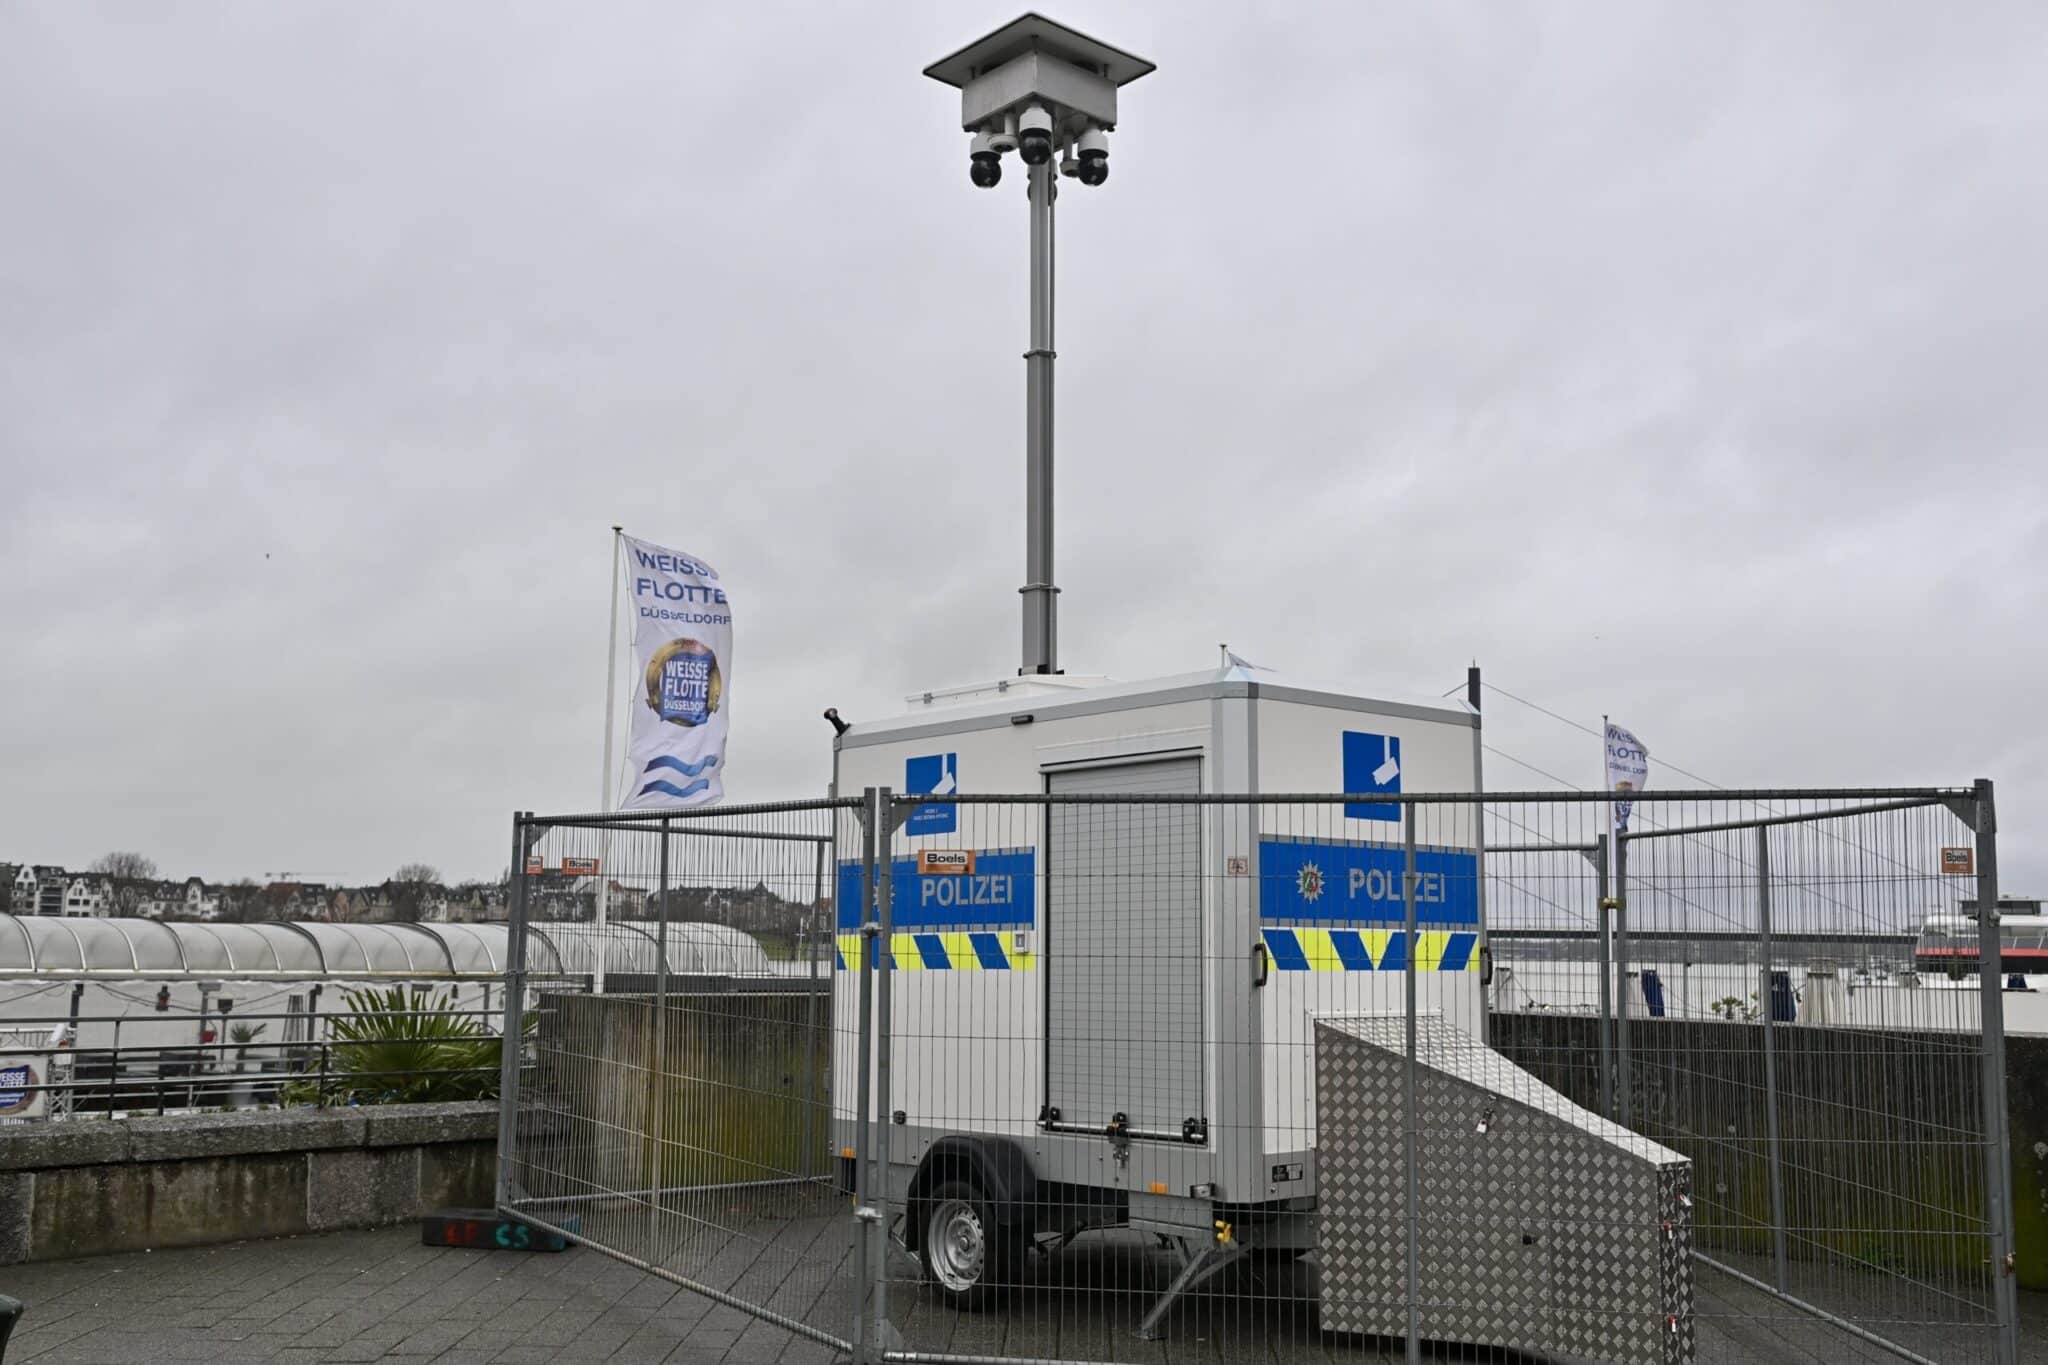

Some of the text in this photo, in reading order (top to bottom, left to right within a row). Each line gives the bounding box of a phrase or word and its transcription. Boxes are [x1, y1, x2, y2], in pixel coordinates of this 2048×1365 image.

[635, 549, 709, 577] WEISS
[637, 577, 729, 604] FLOTTE
[640, 605, 732, 624] DÜSSELDORF
[665, 660, 709, 680] WEISSE
[664, 678, 709, 698] FLOTTE
[927, 853, 966, 863] Boels
[921, 875, 1013, 907] POLIZEI
[1349, 868, 1446, 903] POLIZEI
[0, 1072, 26, 1082] EISSE
